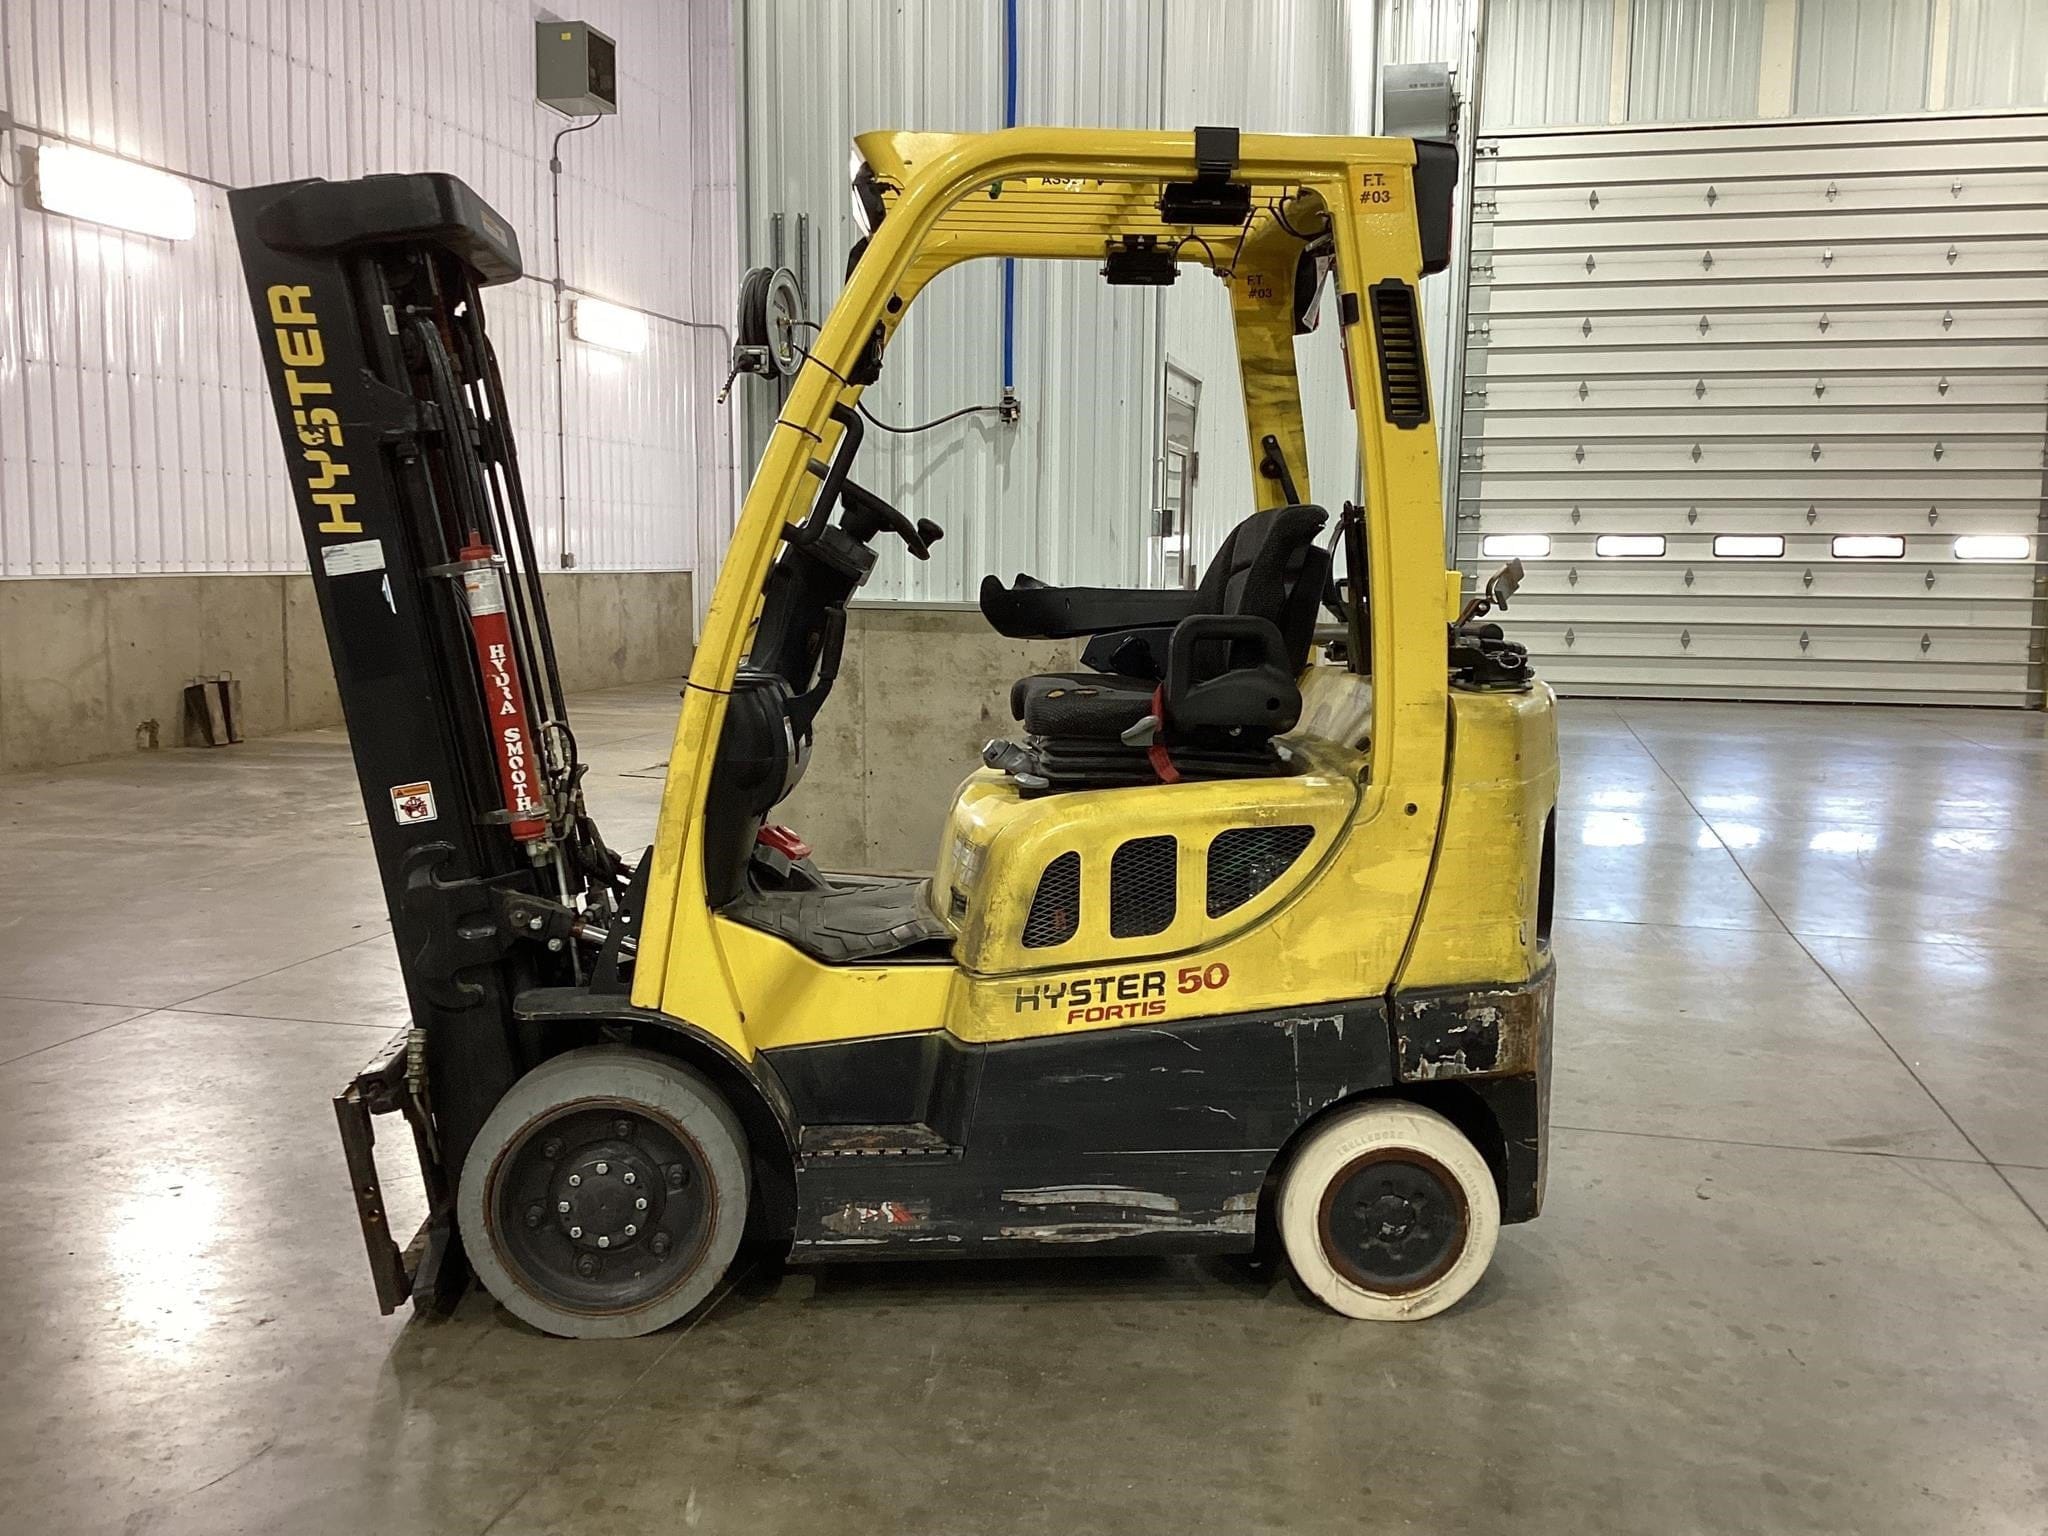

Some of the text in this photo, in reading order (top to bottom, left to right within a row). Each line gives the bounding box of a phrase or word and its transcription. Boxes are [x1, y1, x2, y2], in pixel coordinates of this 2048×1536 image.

[1363, 173, 1386, 187] F.T.
[1360, 190, 1391, 204] #03
[1248, 287, 1273, 299] #03
[267, 284, 363, 534] HYSTER
[503, 727, 533, 812] SMOOTH
[1014, 962, 1230, 1013] HYSTER 50
[1067, 1000, 1167, 1025] FORTIS
